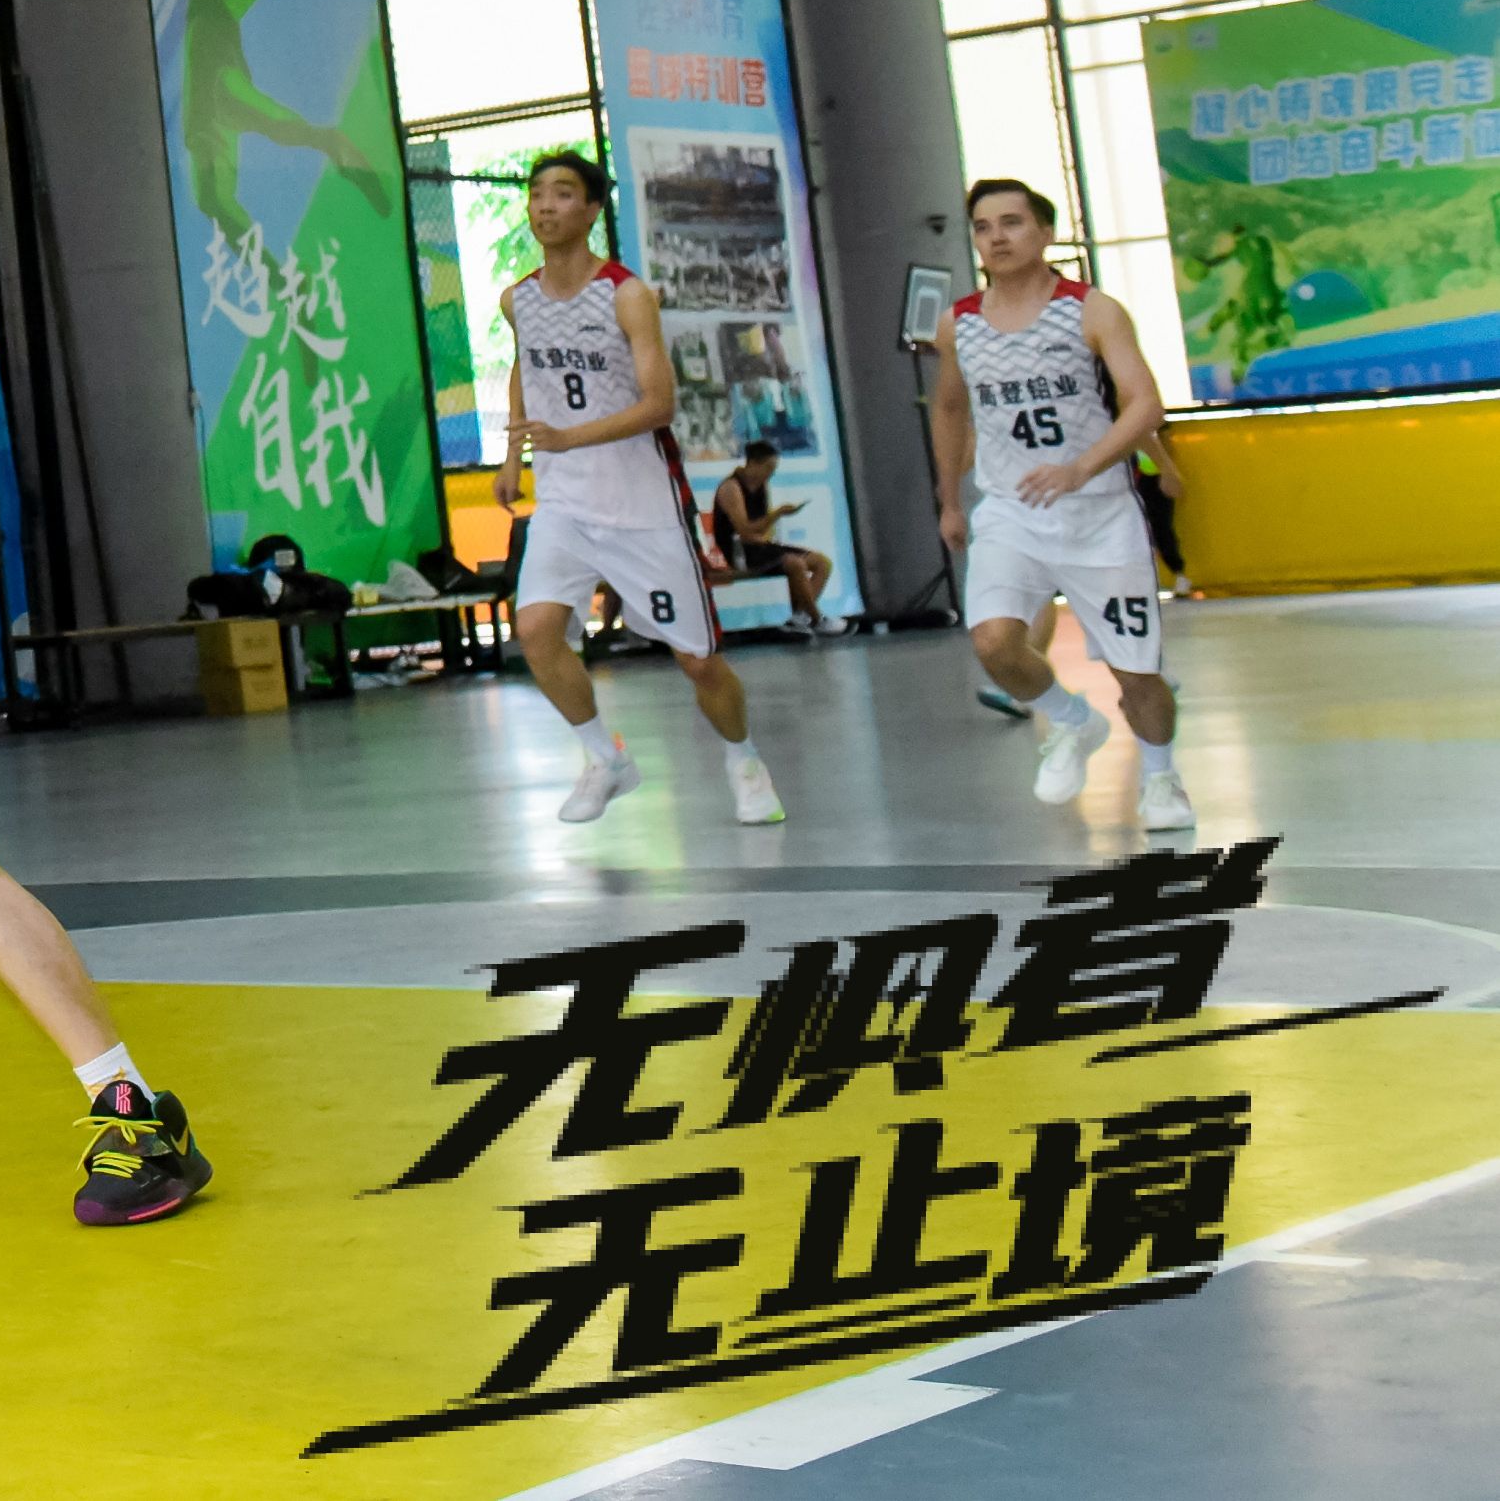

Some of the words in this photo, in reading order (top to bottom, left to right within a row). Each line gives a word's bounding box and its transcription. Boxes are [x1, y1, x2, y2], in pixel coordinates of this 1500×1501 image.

[201, 217, 349, 362] 超越
[563, 373, 587, 410] 8
[238, 352, 387, 527] 自我
[1012, 406, 1065, 449] 45
[650, 590, 675, 624] 8
[1104, 596, 1150, 639] 45
